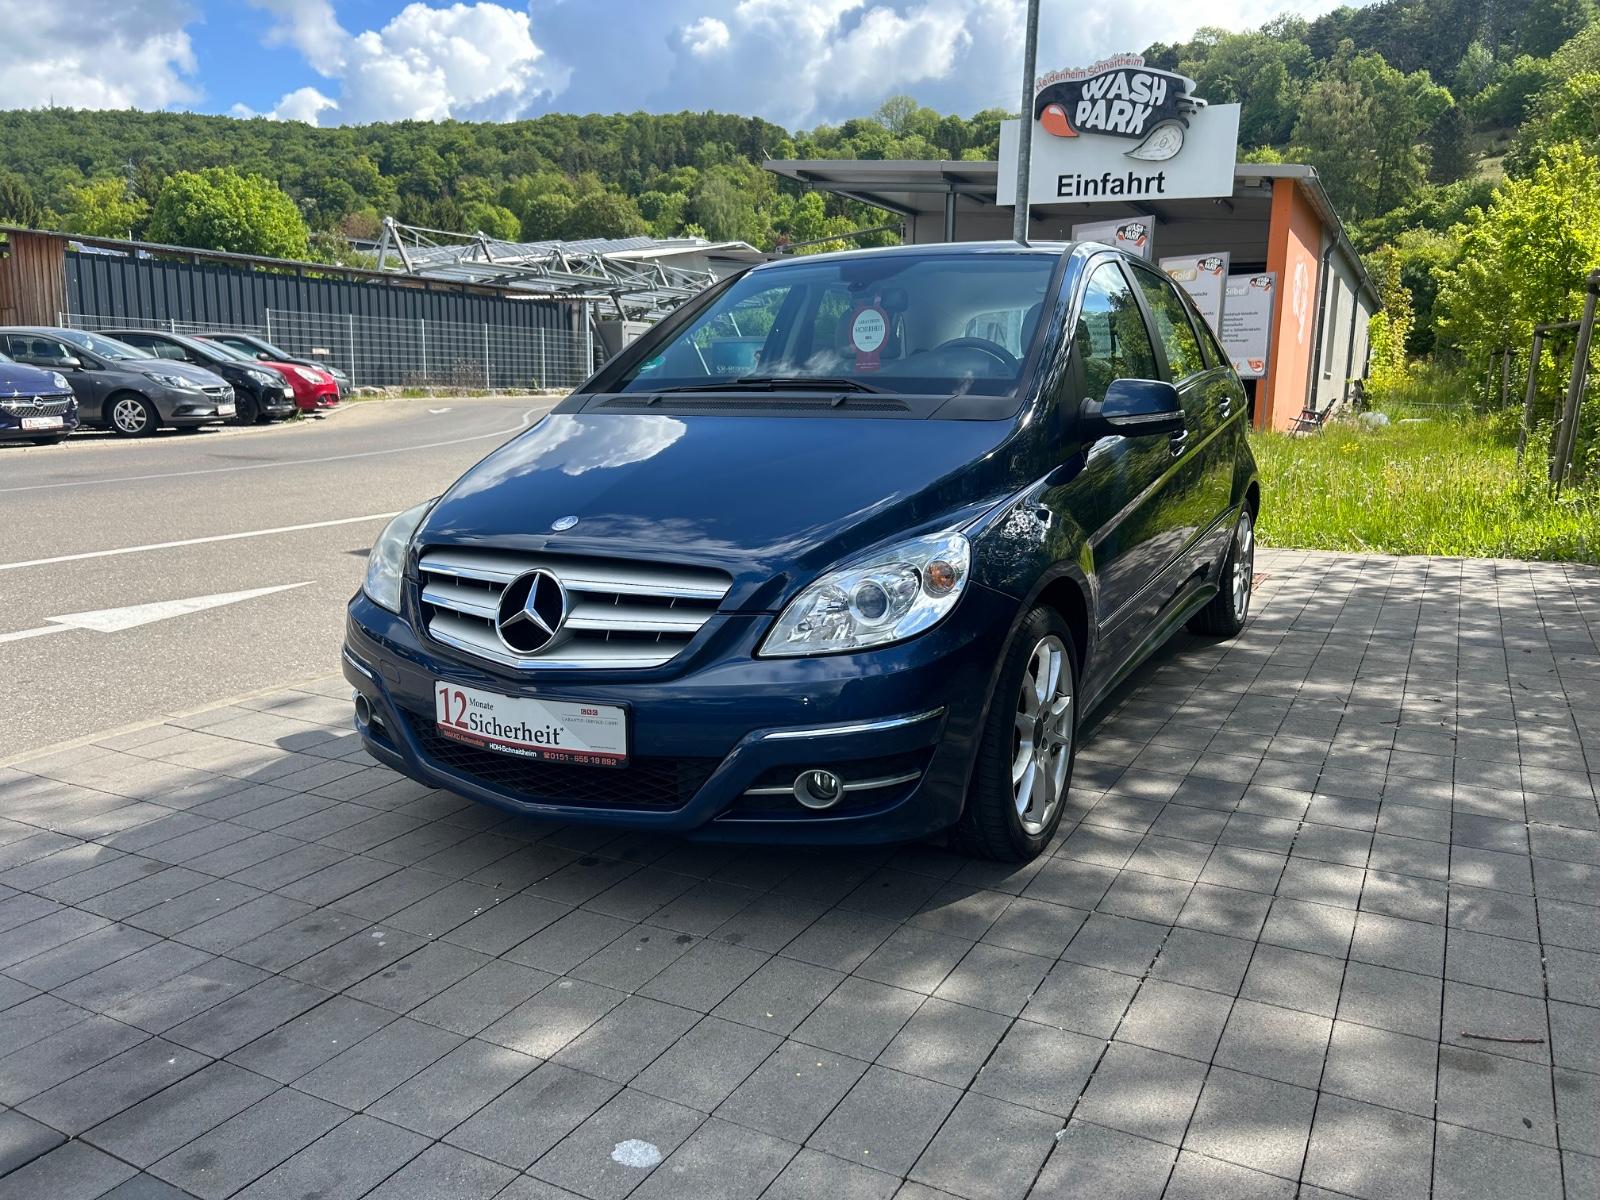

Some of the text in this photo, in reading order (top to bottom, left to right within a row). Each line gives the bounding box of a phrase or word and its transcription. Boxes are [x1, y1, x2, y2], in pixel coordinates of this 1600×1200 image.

[1088, 56, 1143, 76] Schnaitheim
[1081, 72, 1167, 106] WASH
[1075, 100, 1153, 135] PARK
[1056, 171, 1166, 198] Einfahrt
[1171, 271, 1191, 280] Gold
[438, 687, 469, 731] 12
[469, 697, 494, 712] Monate
